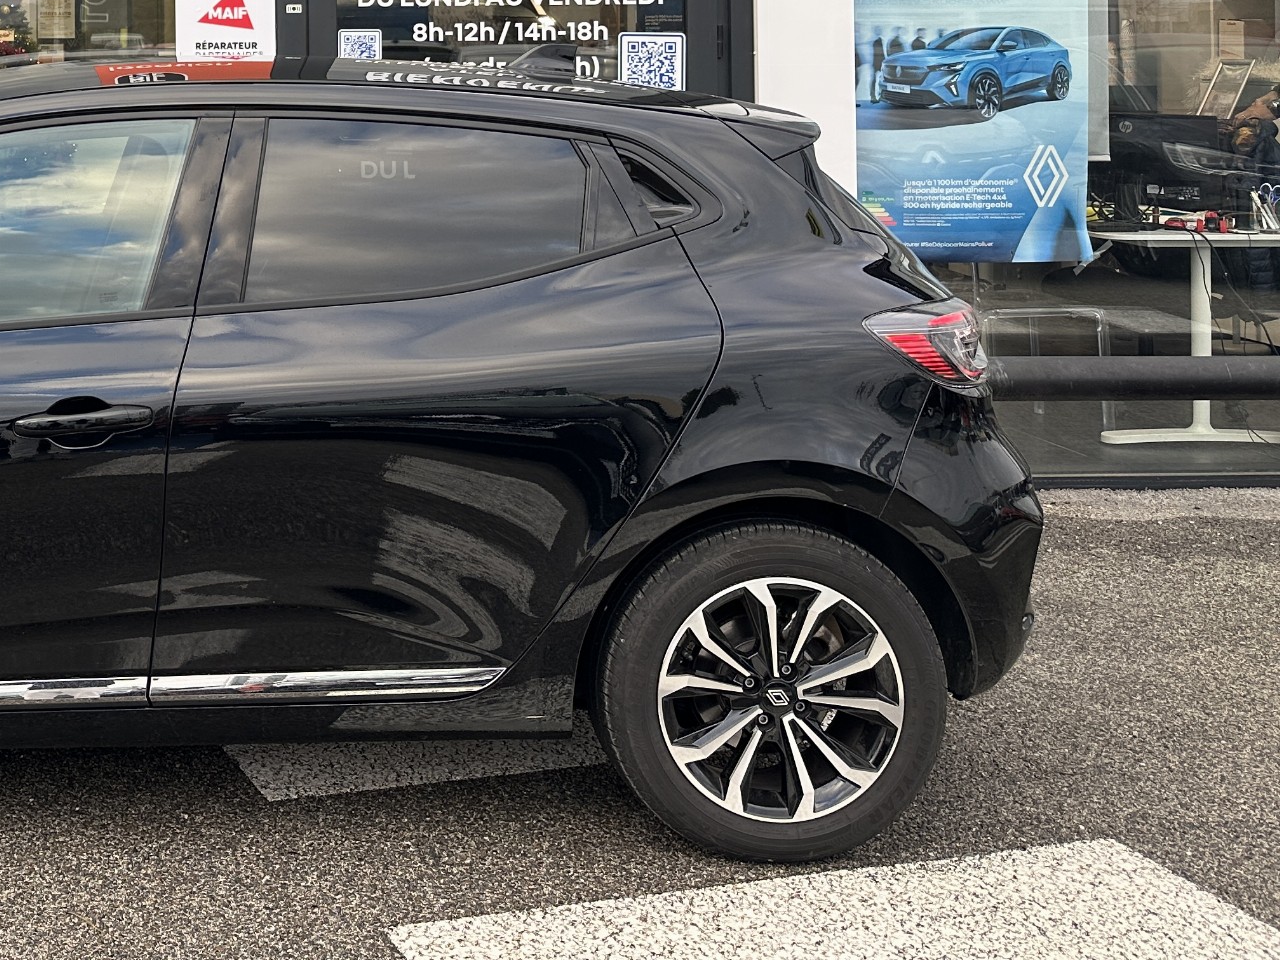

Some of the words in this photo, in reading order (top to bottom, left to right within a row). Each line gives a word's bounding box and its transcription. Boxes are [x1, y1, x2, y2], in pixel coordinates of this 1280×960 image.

[208, 7, 247, 20] MAIF
[412, 22, 495, 42] 8h-12h
[515, 20, 609, 42] 14h-18h
[195, 40, 258, 50] RÉPARATEUR
[360, 160, 397, 179] DU
[903, 187, 945, 195] disponible
[945, 187, 1004, 195] prochainement
[931, 201, 960, 209] hybride
[960, 201, 1012, 209] rechargeable
